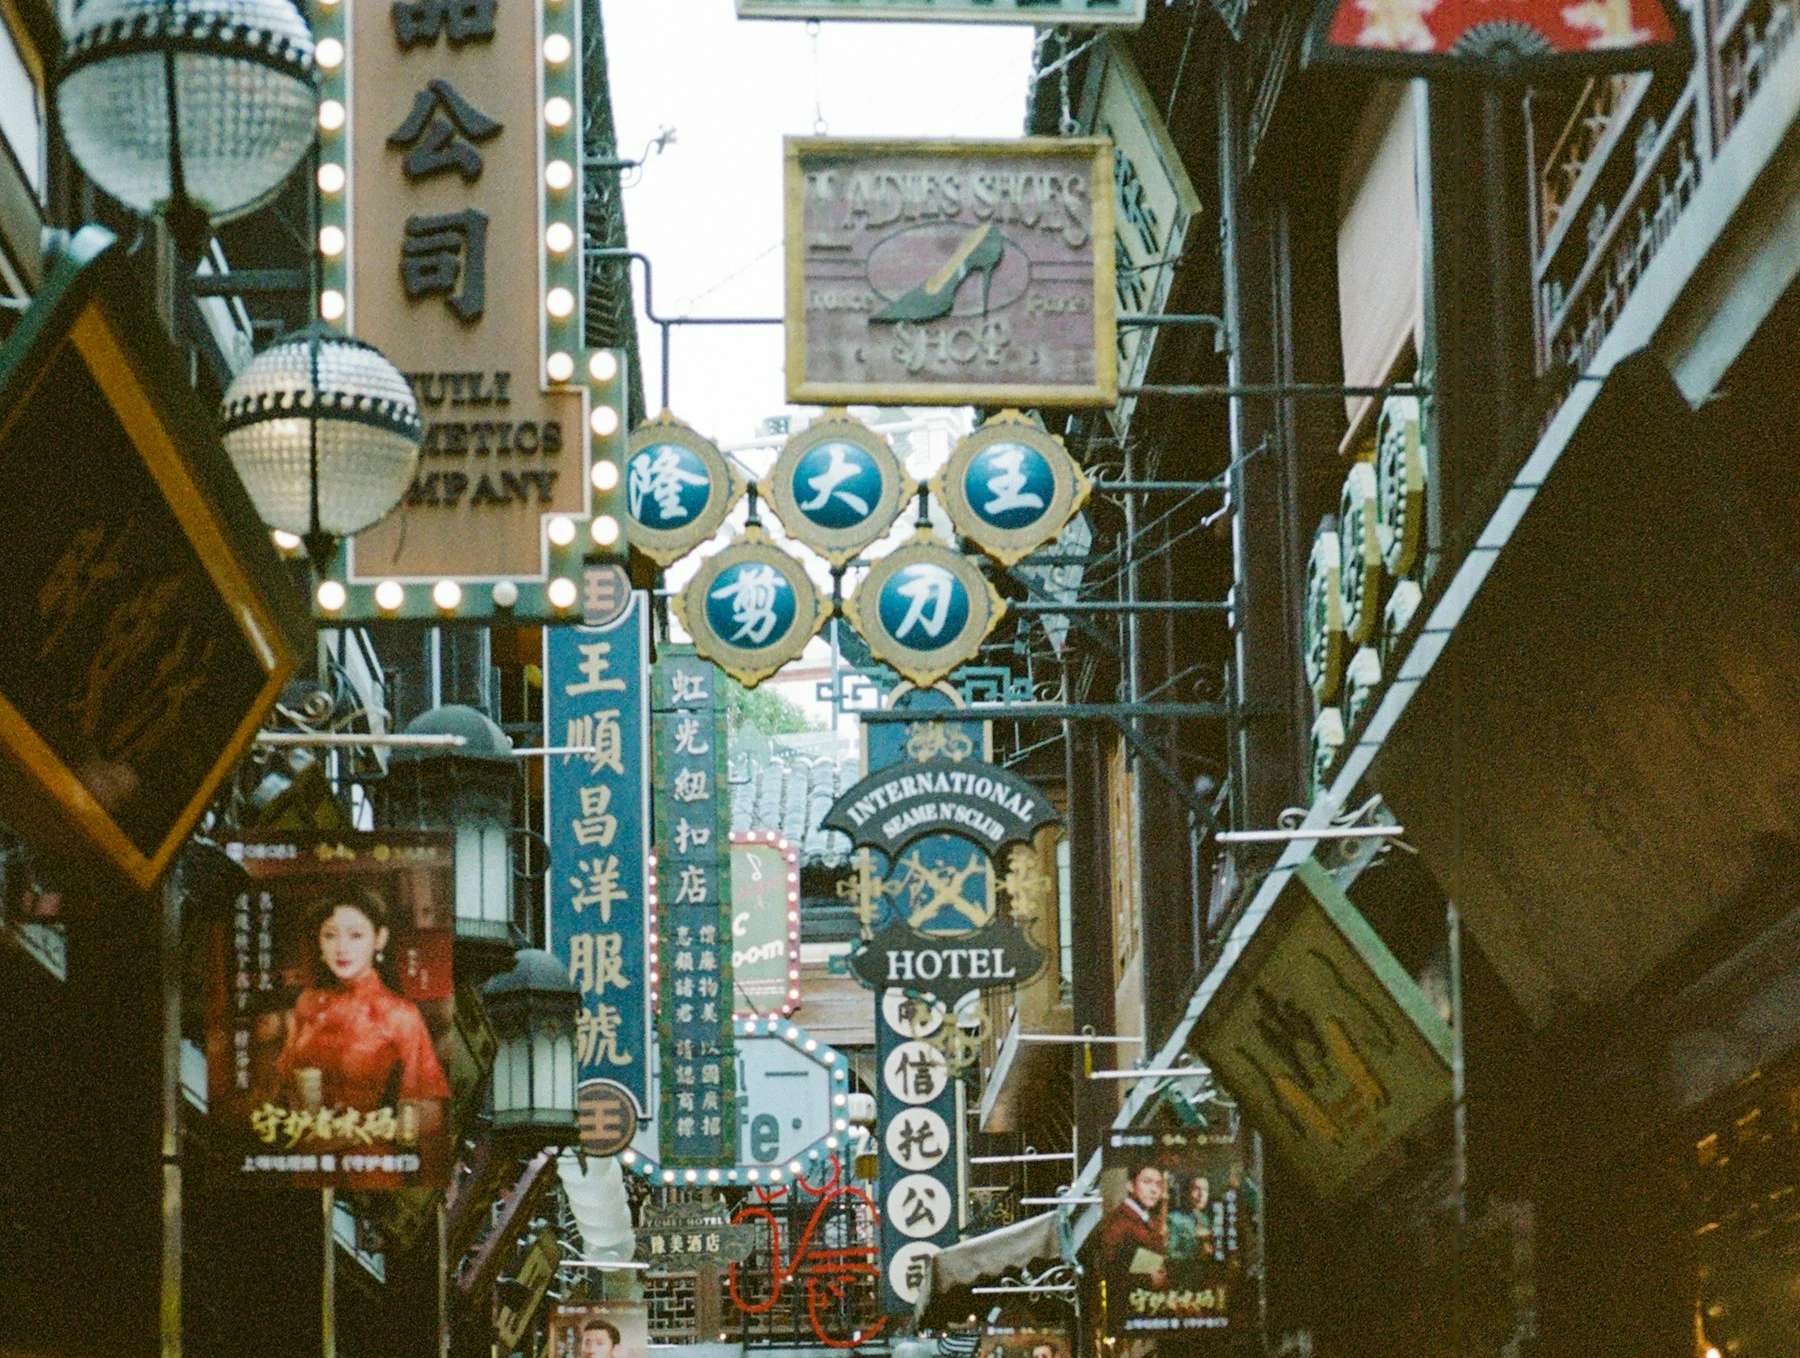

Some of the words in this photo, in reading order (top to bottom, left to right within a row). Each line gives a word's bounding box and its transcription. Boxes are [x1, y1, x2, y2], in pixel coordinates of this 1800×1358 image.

[892, 316, 1011, 375] SHOP
[403, 468, 559, 507] MPANY
[846, 770, 1036, 828] INTERNATIONAL
[563, 641, 632, 1068] 王順昌洋服號
[732, 939, 785, 969] oom
[885, 949, 1017, 981] HOTEL
[686, 1216, 724, 1227] HOTEL
